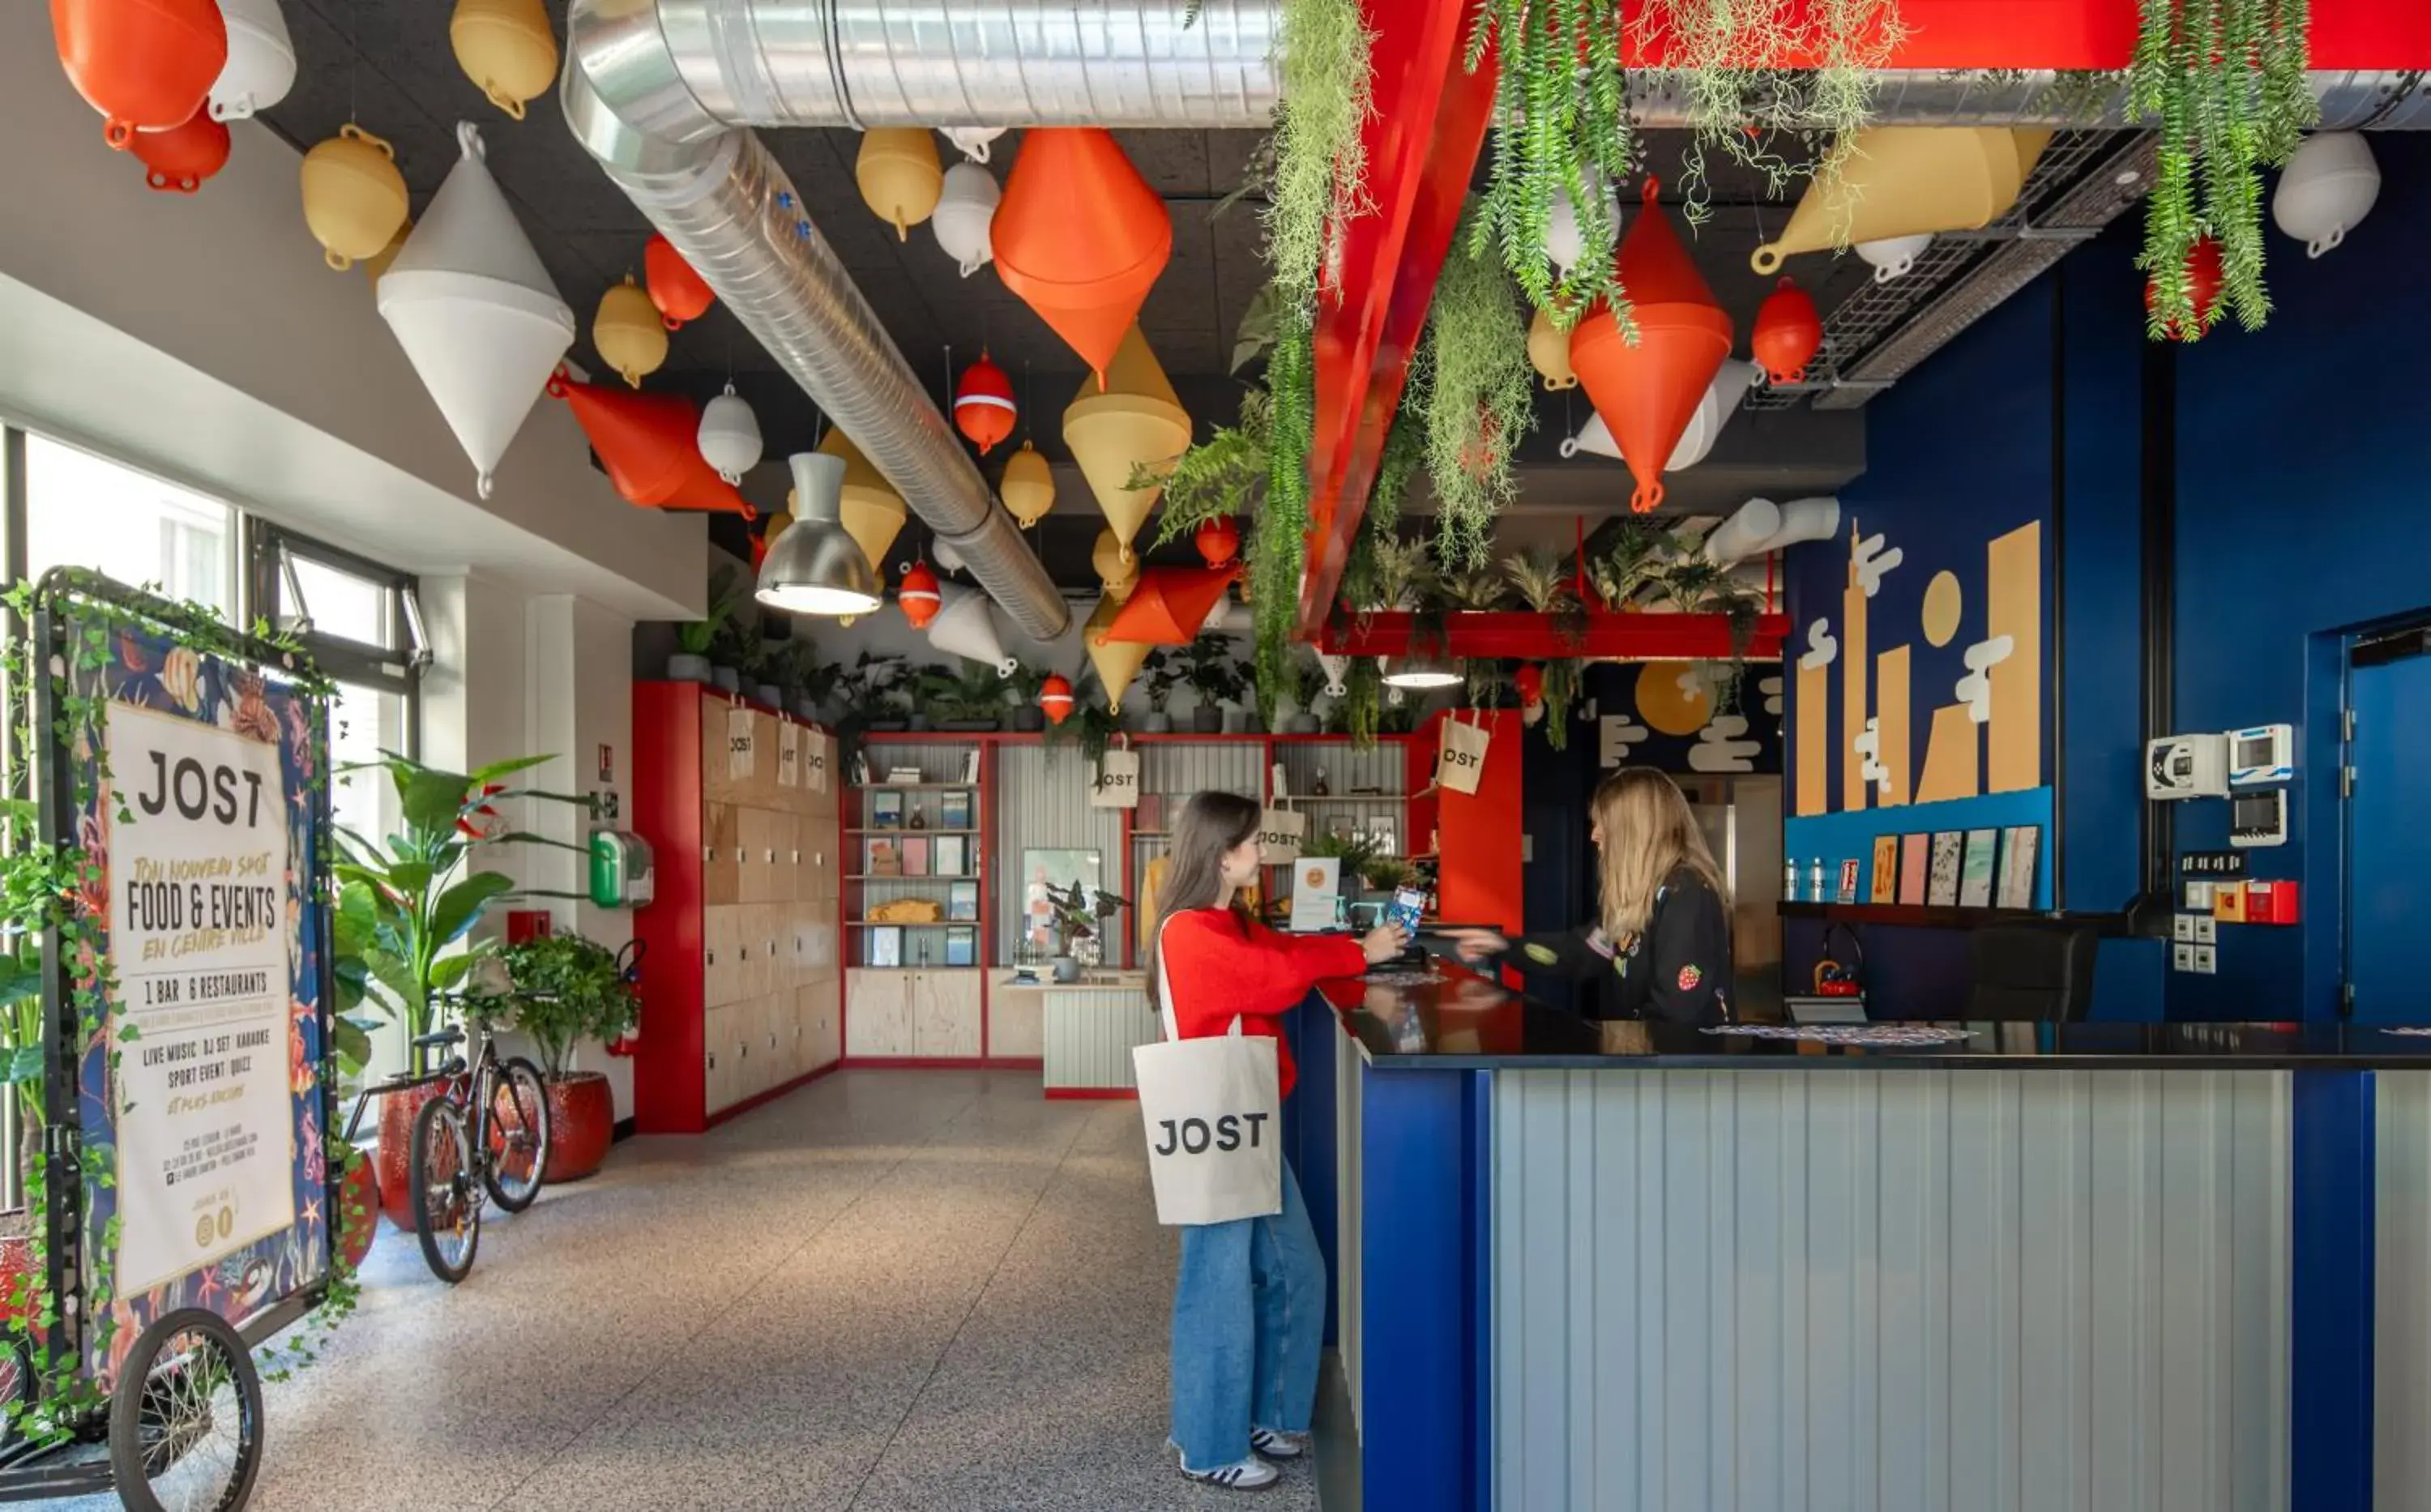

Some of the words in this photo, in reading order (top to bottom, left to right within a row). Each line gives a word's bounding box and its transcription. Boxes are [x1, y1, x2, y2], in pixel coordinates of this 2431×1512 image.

[1444, 748, 1479, 769] OST
[138, 750, 262, 828] JOST
[1103, 773, 1134, 787] OST
[237, 851, 272, 878] SPOT
[127, 880, 182, 931] FOOD
[190, 882, 203, 929] &
[211, 883, 276, 930] EVENTS
[142, 936, 166, 962] EN
[170, 927, 226, 959] CENTRE
[144, 980, 152, 1005] 1
[156, 978, 180, 1004] BAR
[189, 976, 197, 1000] 6
[199, 972, 267, 999] RESTAURANTS
[143, 1046, 165, 1067] LIVE
[166, 1040, 197, 1062] MUSIC
[203, 1038, 214, 1056] DJ
[216, 1035, 231, 1053] SET
[236, 1027, 271, 1049] KARAOKE
[168, 1066, 197, 1089] SPORT
[199, 1061, 225, 1083] EVENT
[1155, 1113, 1269, 1156] JOST
